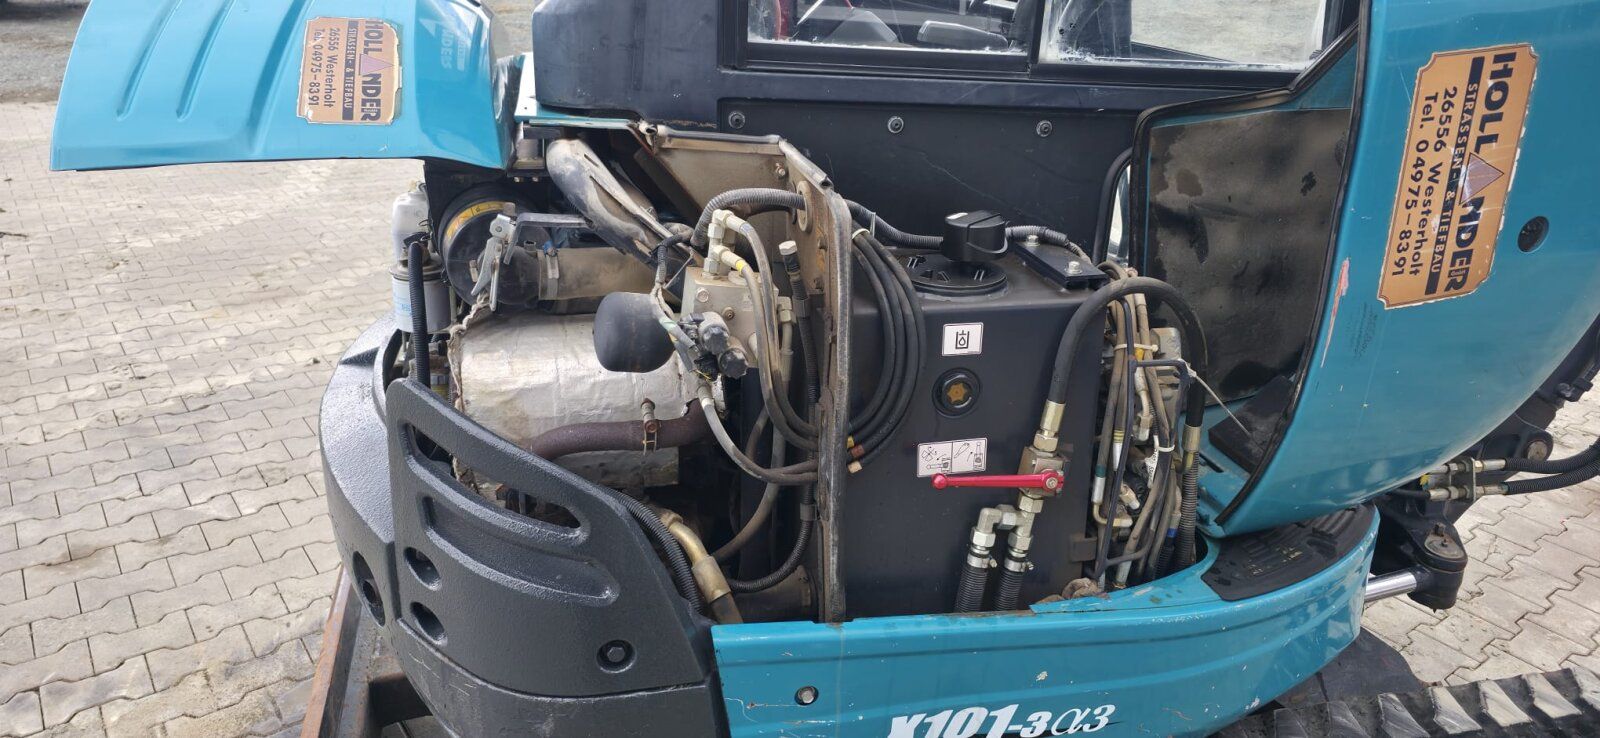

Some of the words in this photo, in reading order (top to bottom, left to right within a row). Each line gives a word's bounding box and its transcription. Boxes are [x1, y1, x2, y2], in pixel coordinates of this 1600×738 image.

[328, 27, 341, 51] 26556
[323, 55, 338, 108] Westerholt
[344, 76, 354, 108] TIEFBAU
[1419, 91, 1439, 130] Tel.
[1433, 86, 1458, 153] 26556
[1447, 190, 1456, 201] &
[1409, 162, 1444, 276] Westerholt
[1431, 210, 1452, 274] TIEFBAU
